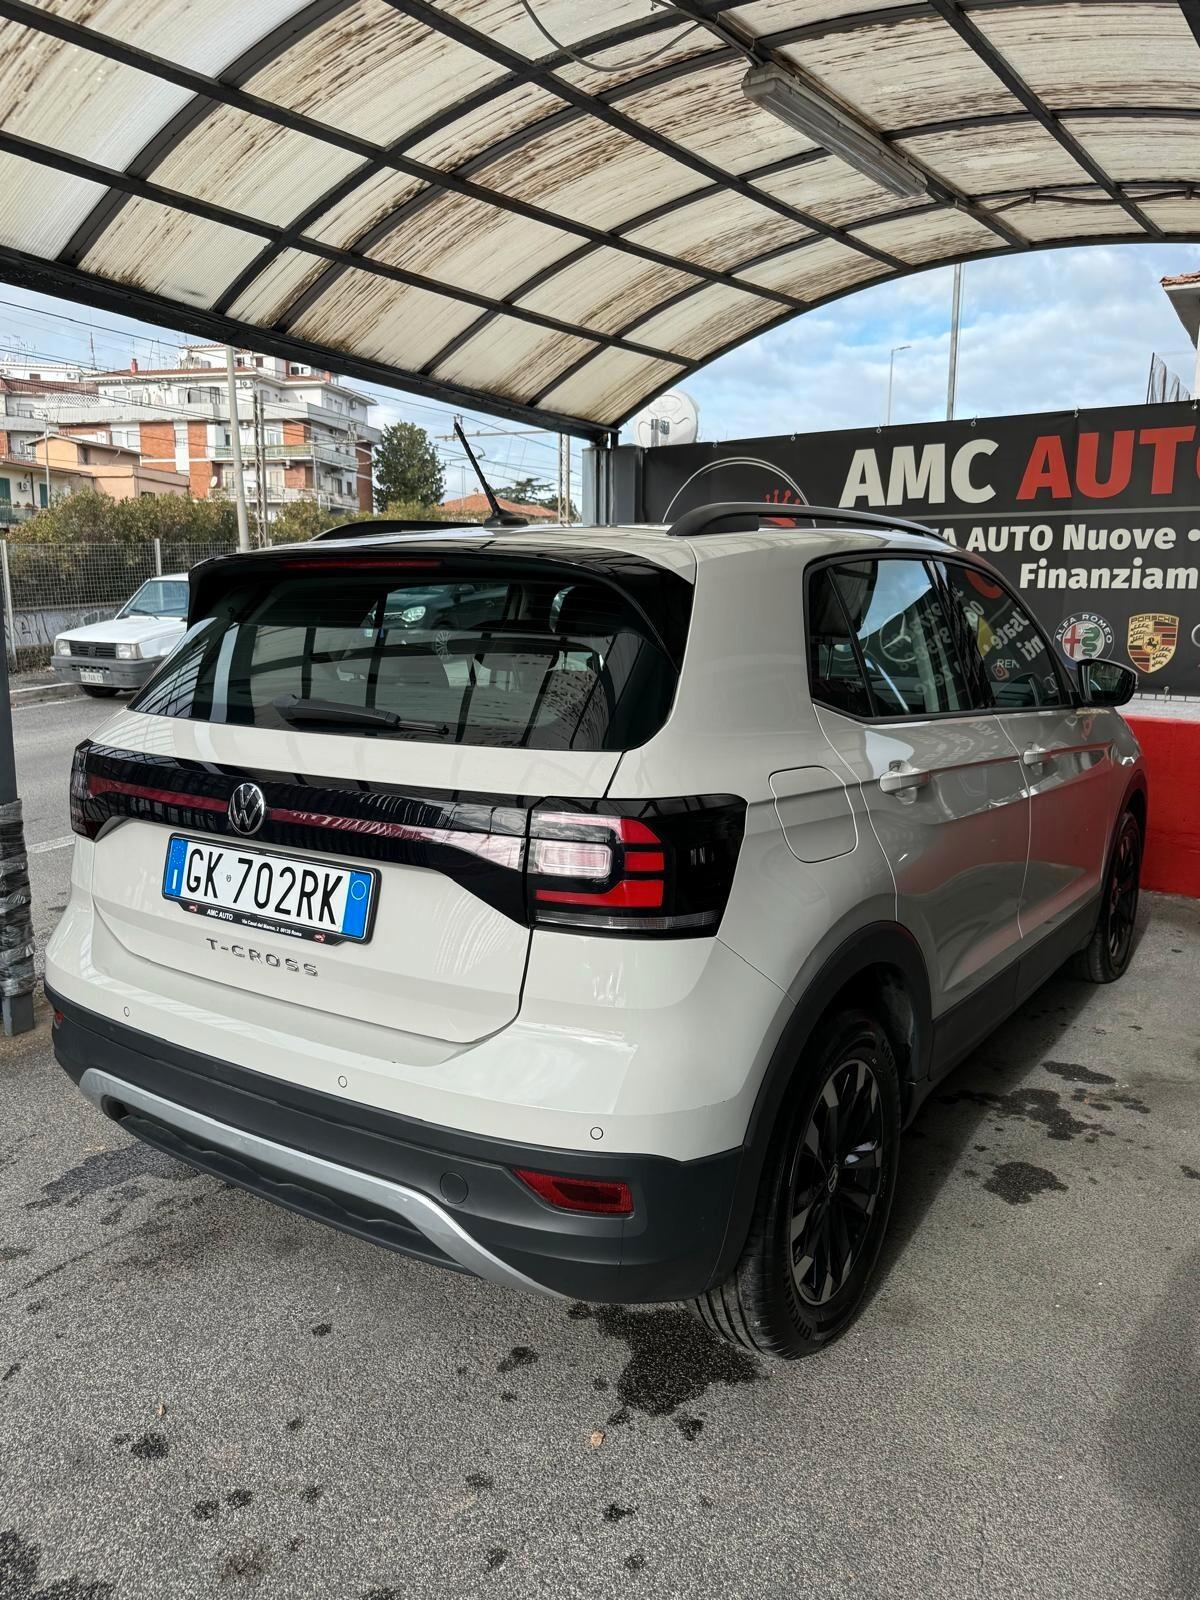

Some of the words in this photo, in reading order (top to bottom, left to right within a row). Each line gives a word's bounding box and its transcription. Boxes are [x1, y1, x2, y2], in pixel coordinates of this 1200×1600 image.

[838, 438, 999, 508] AMC
[1016, 425, 1200, 500] AUT
[966, 524, 1053, 552] AUTO
[1062, 524, 1177, 551] Nuove
[1055, 617, 1077, 642] ALFA
[1081, 614, 1113, 643] ROMEO
[1130, 615, 1177, 624] PORSCHE
[186, 848, 224, 899] GK
[232, 857, 343, 925] 702RK
[206, 909, 219, 917] AMC
[219, 912, 234, 921] AUTO
[206, 938, 318, 977] T-CROSS
